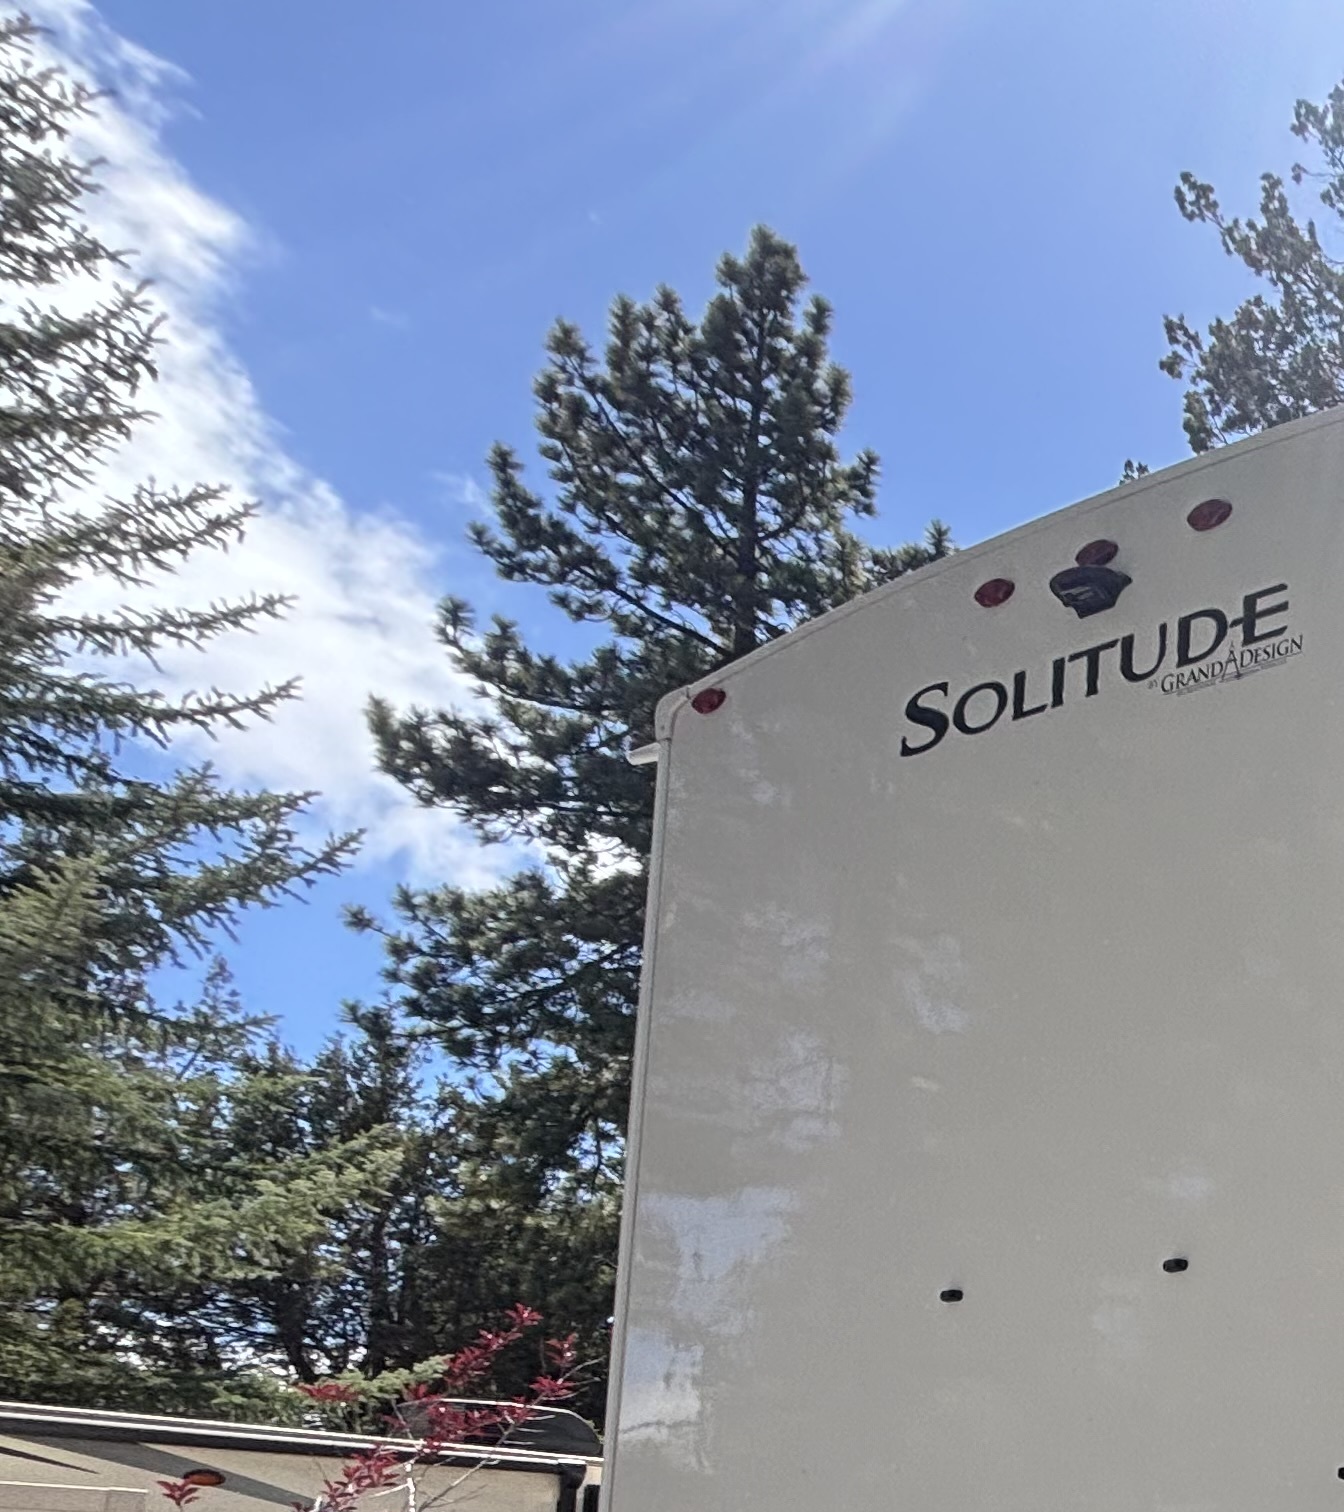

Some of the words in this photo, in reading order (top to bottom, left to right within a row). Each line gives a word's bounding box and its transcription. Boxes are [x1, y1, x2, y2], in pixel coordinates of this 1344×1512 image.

[900, 583, 1289, 757] SOLITUDE
[1160, 660, 1224, 693] GRAND
[1240, 633, 1304, 669] DESIGN
